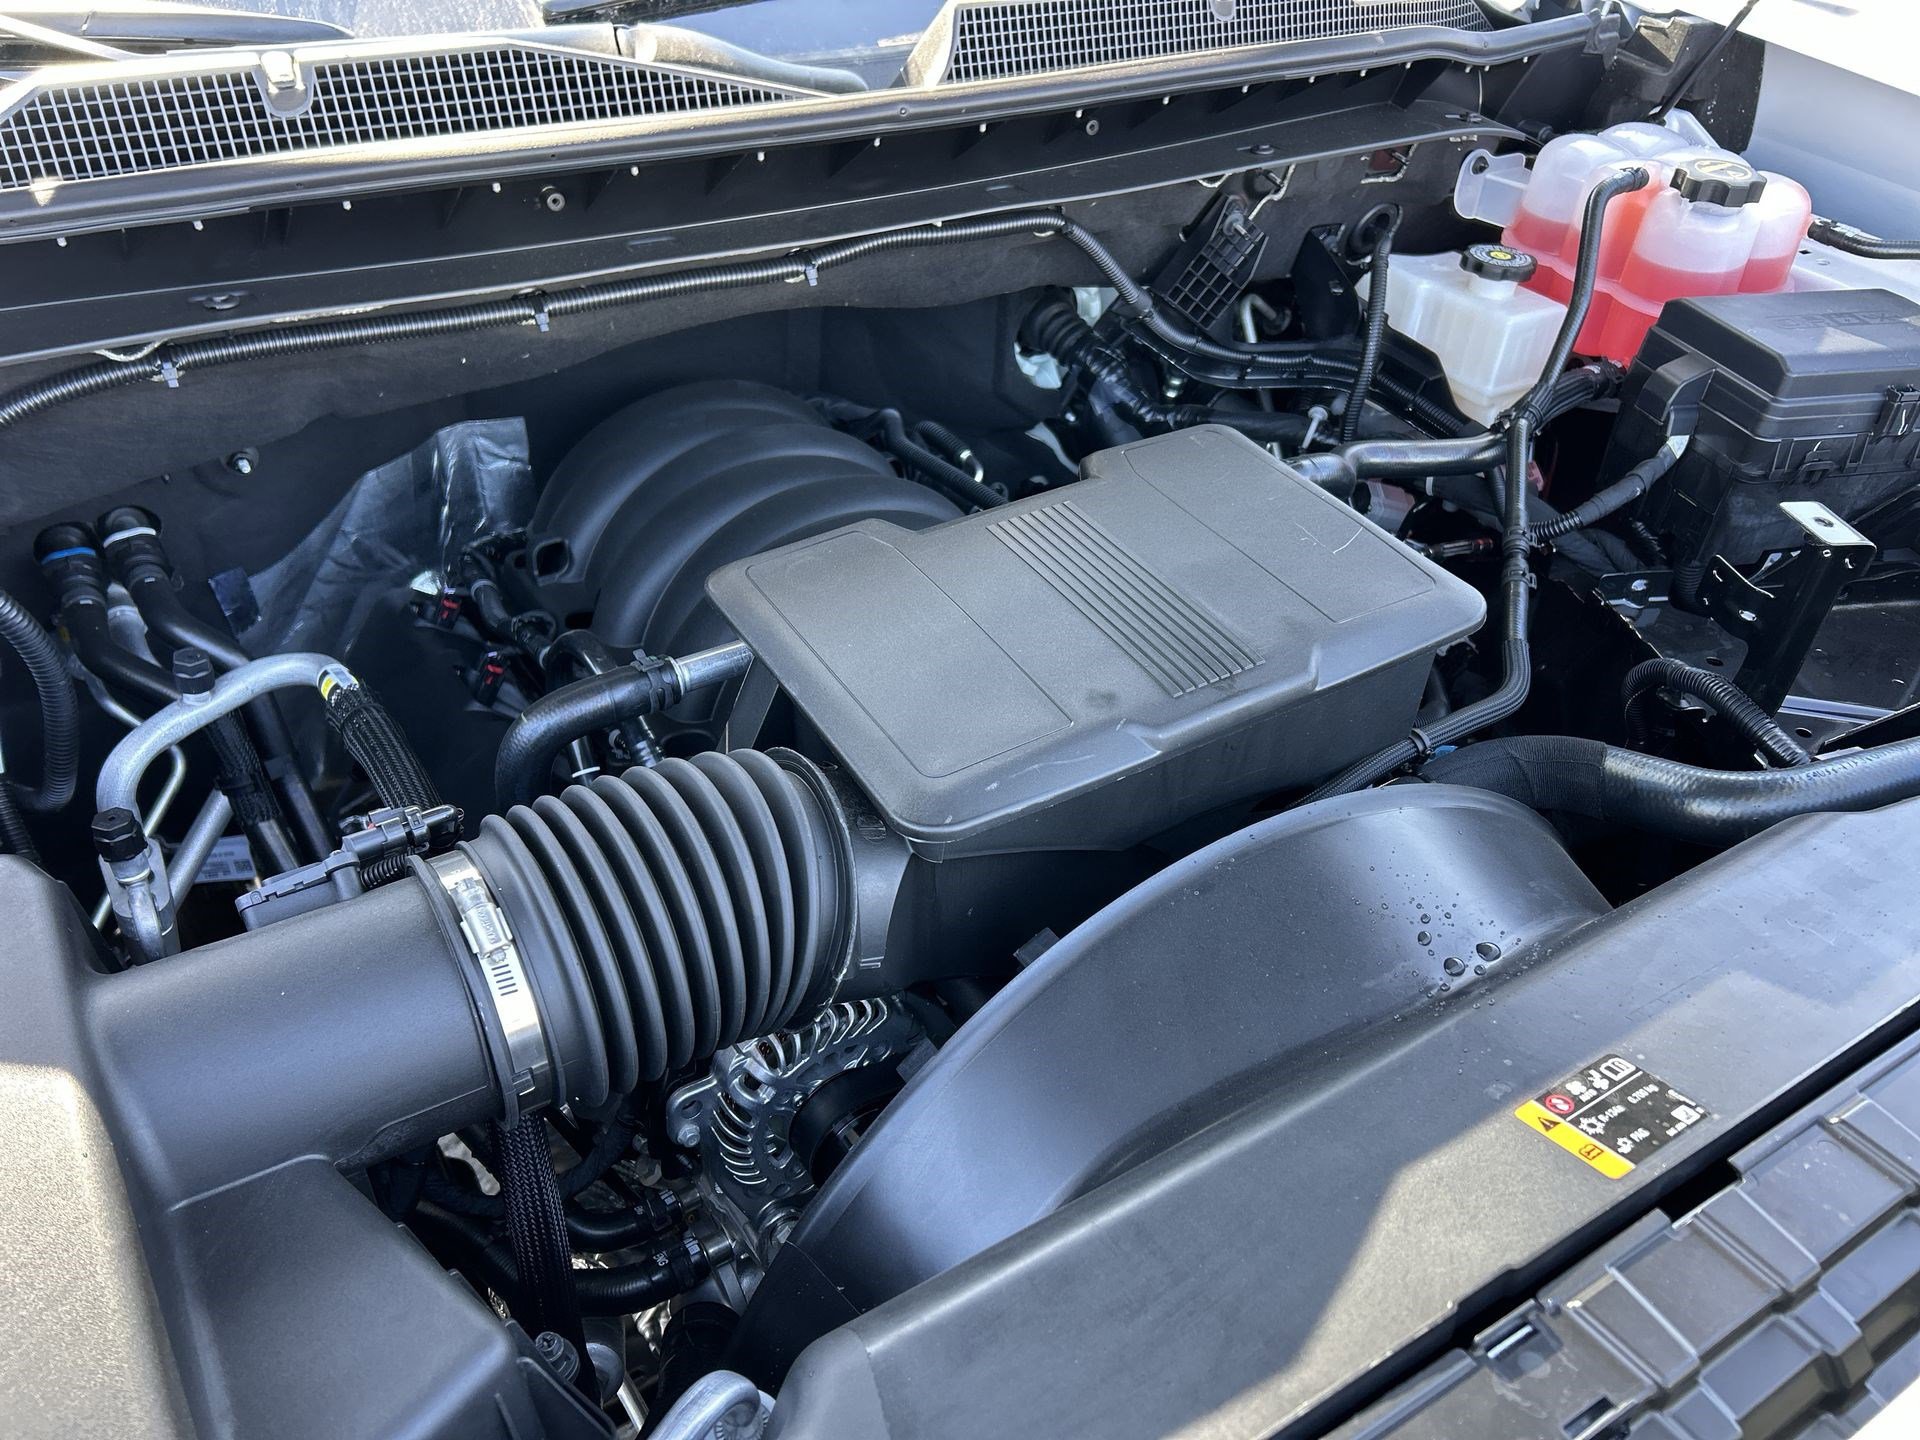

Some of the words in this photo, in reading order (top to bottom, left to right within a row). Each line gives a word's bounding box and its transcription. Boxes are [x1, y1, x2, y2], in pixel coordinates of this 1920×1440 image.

[1643, 1084, 1659, 1093] kg
[1630, 1128, 1650, 1142] PAG
[653, 1252, 669, 1267] ENG
